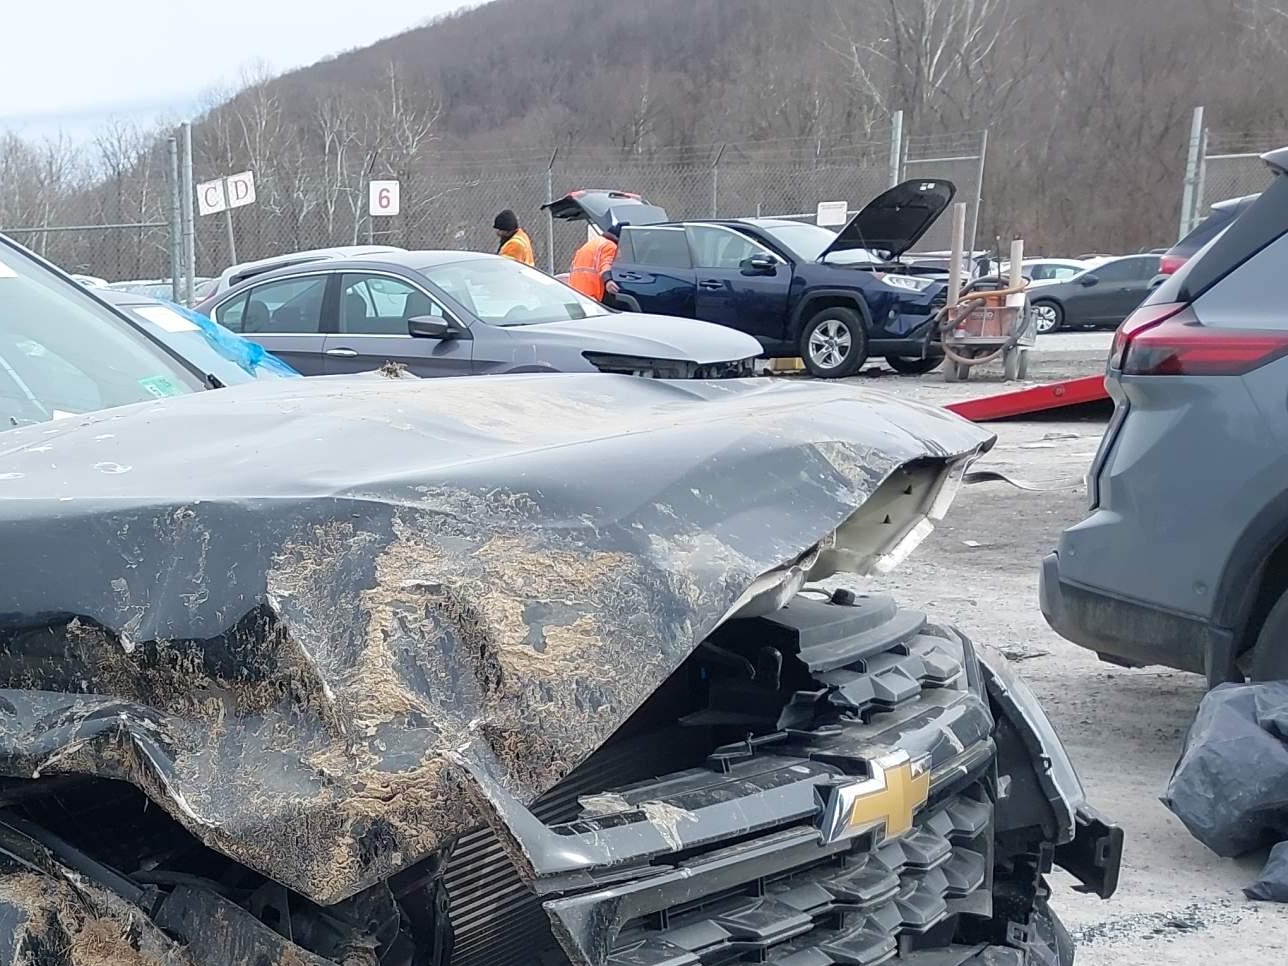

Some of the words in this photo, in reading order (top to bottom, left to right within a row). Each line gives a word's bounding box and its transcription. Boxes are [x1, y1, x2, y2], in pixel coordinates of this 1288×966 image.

[204, 186, 218, 208] C
[234, 179, 249, 201] D
[378, 187, 391, 209] 6
